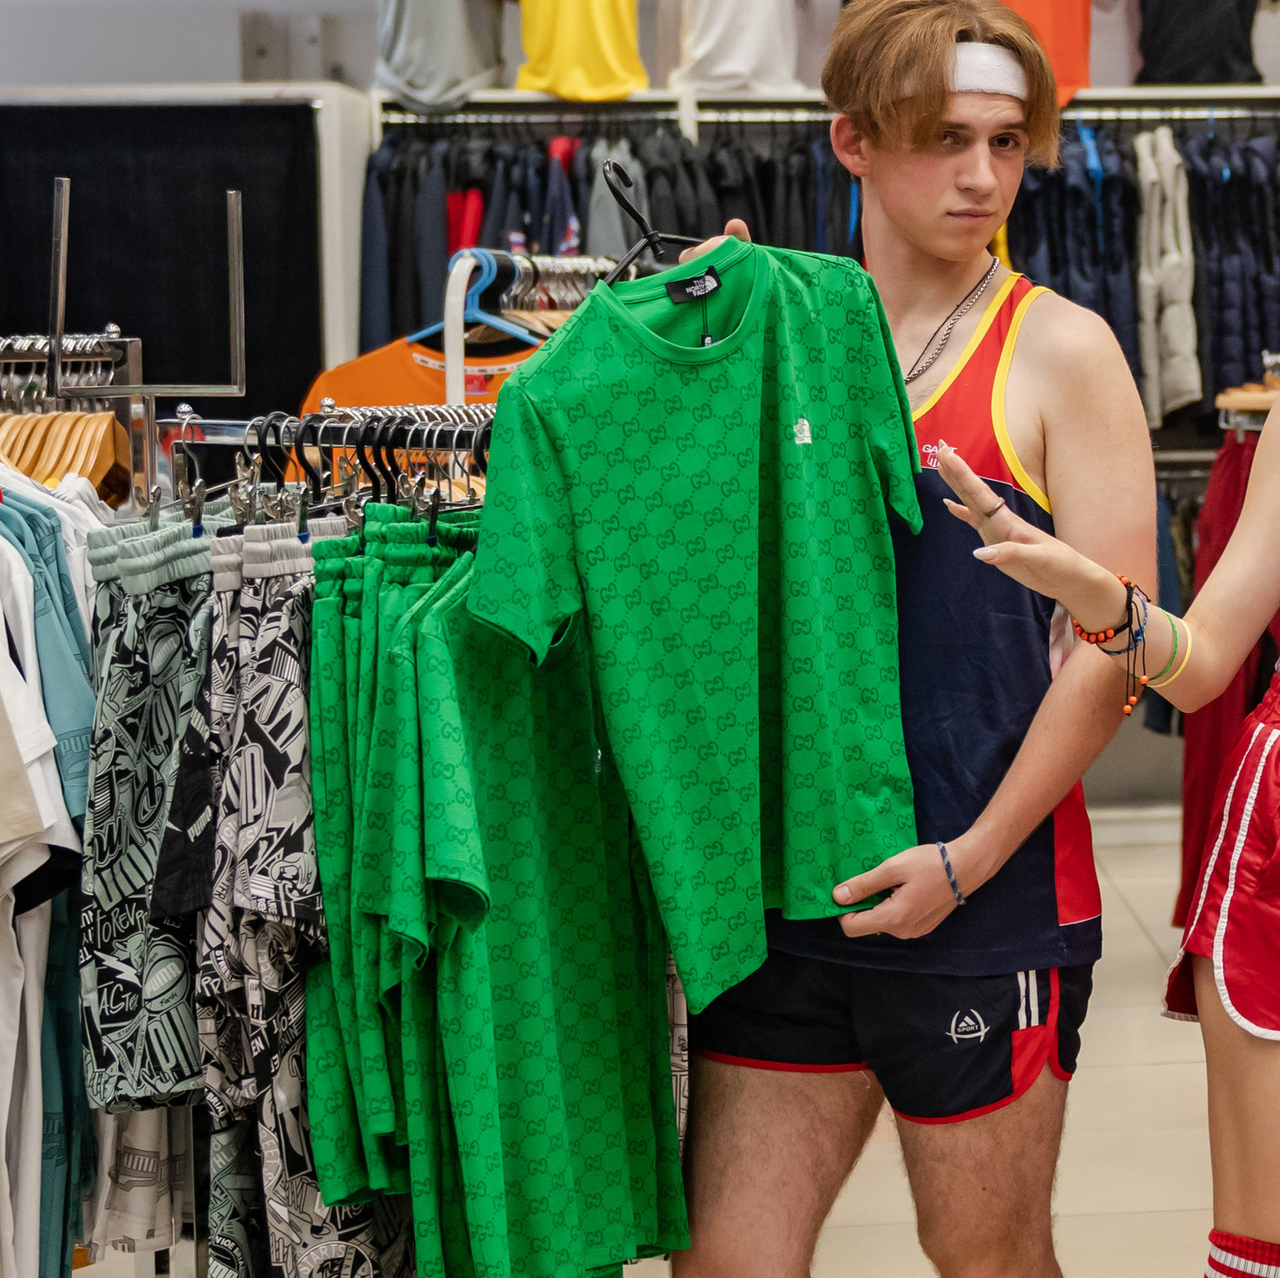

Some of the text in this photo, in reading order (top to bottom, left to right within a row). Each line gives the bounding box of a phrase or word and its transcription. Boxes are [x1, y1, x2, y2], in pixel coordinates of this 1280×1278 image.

[922, 443, 958, 454] GAT
[187, 805, 213, 843] PUMA
[957, 1025, 979, 1033] SPORT
[123, 1152, 158, 1173] UMA
